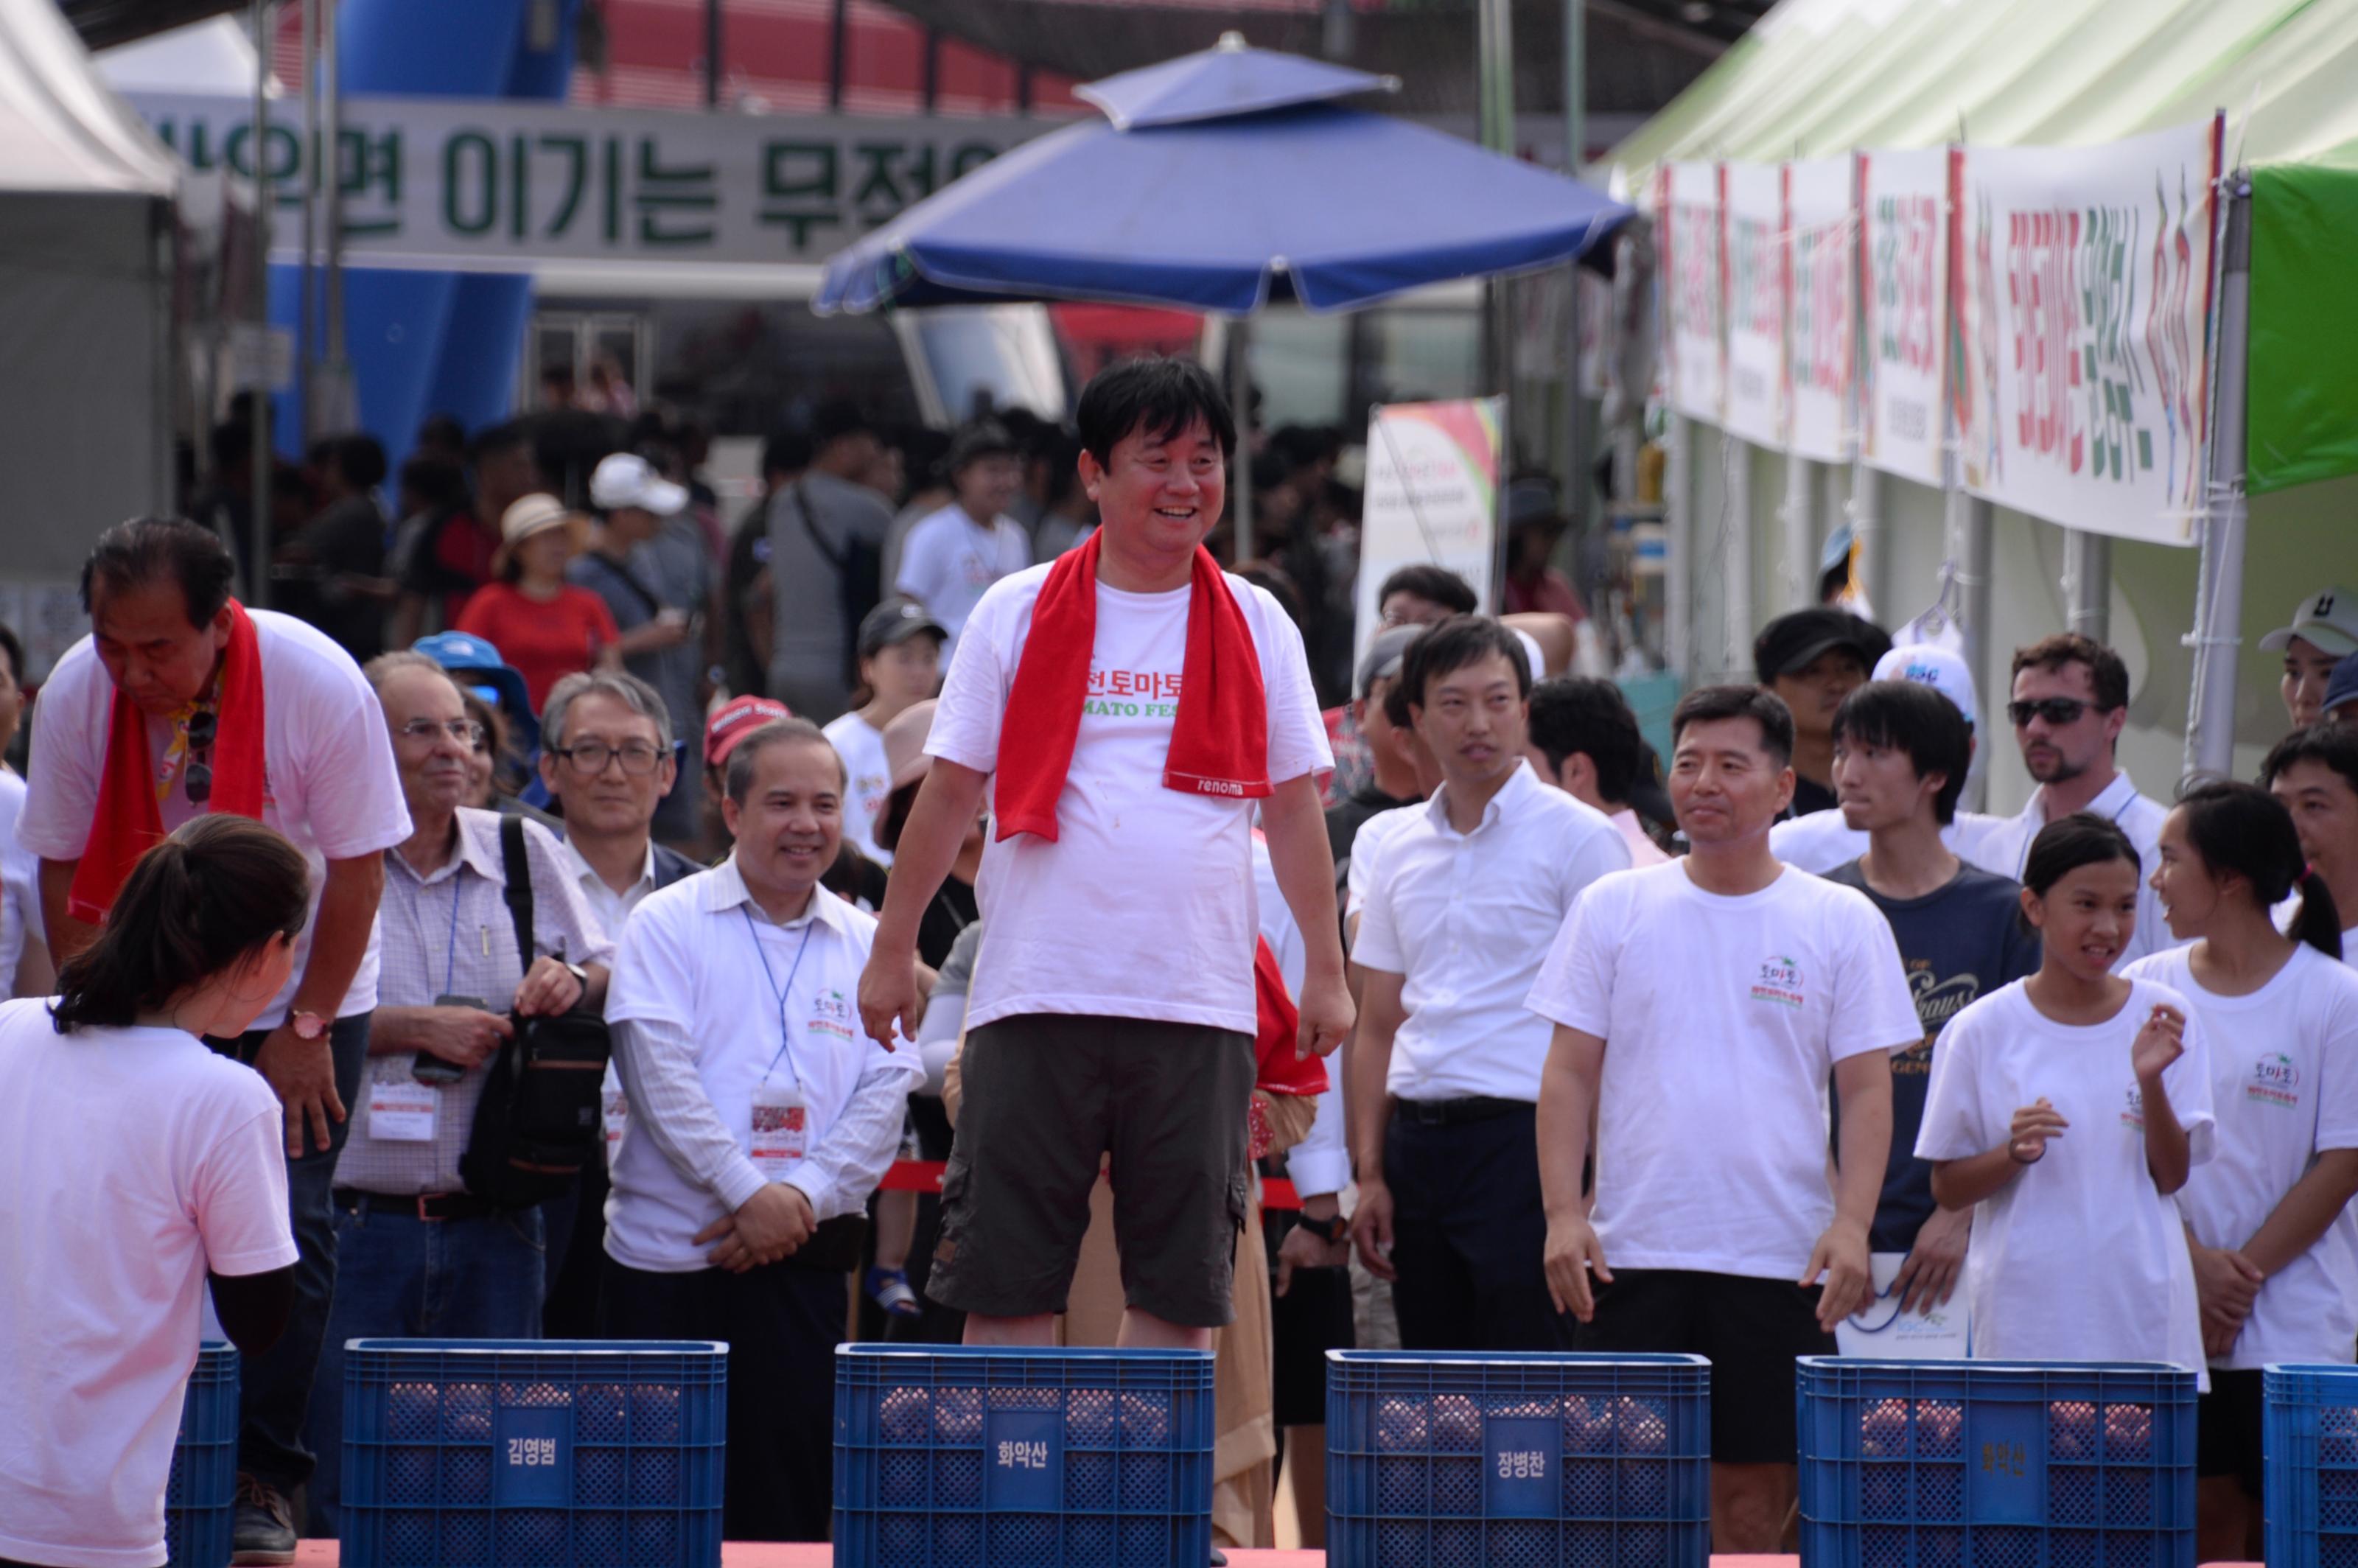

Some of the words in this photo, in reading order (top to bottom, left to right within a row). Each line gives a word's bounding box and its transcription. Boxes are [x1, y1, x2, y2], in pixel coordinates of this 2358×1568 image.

[444, 131, 718, 248] 이기는
[758, 137, 997, 250] 무적
[1197, 779, 1244, 796] renoma
[507, 1438, 556, 1466] 김영범
[998, 1441, 1048, 1469] 화악산
[1497, 1451, 1545, 1479] 장병찬
